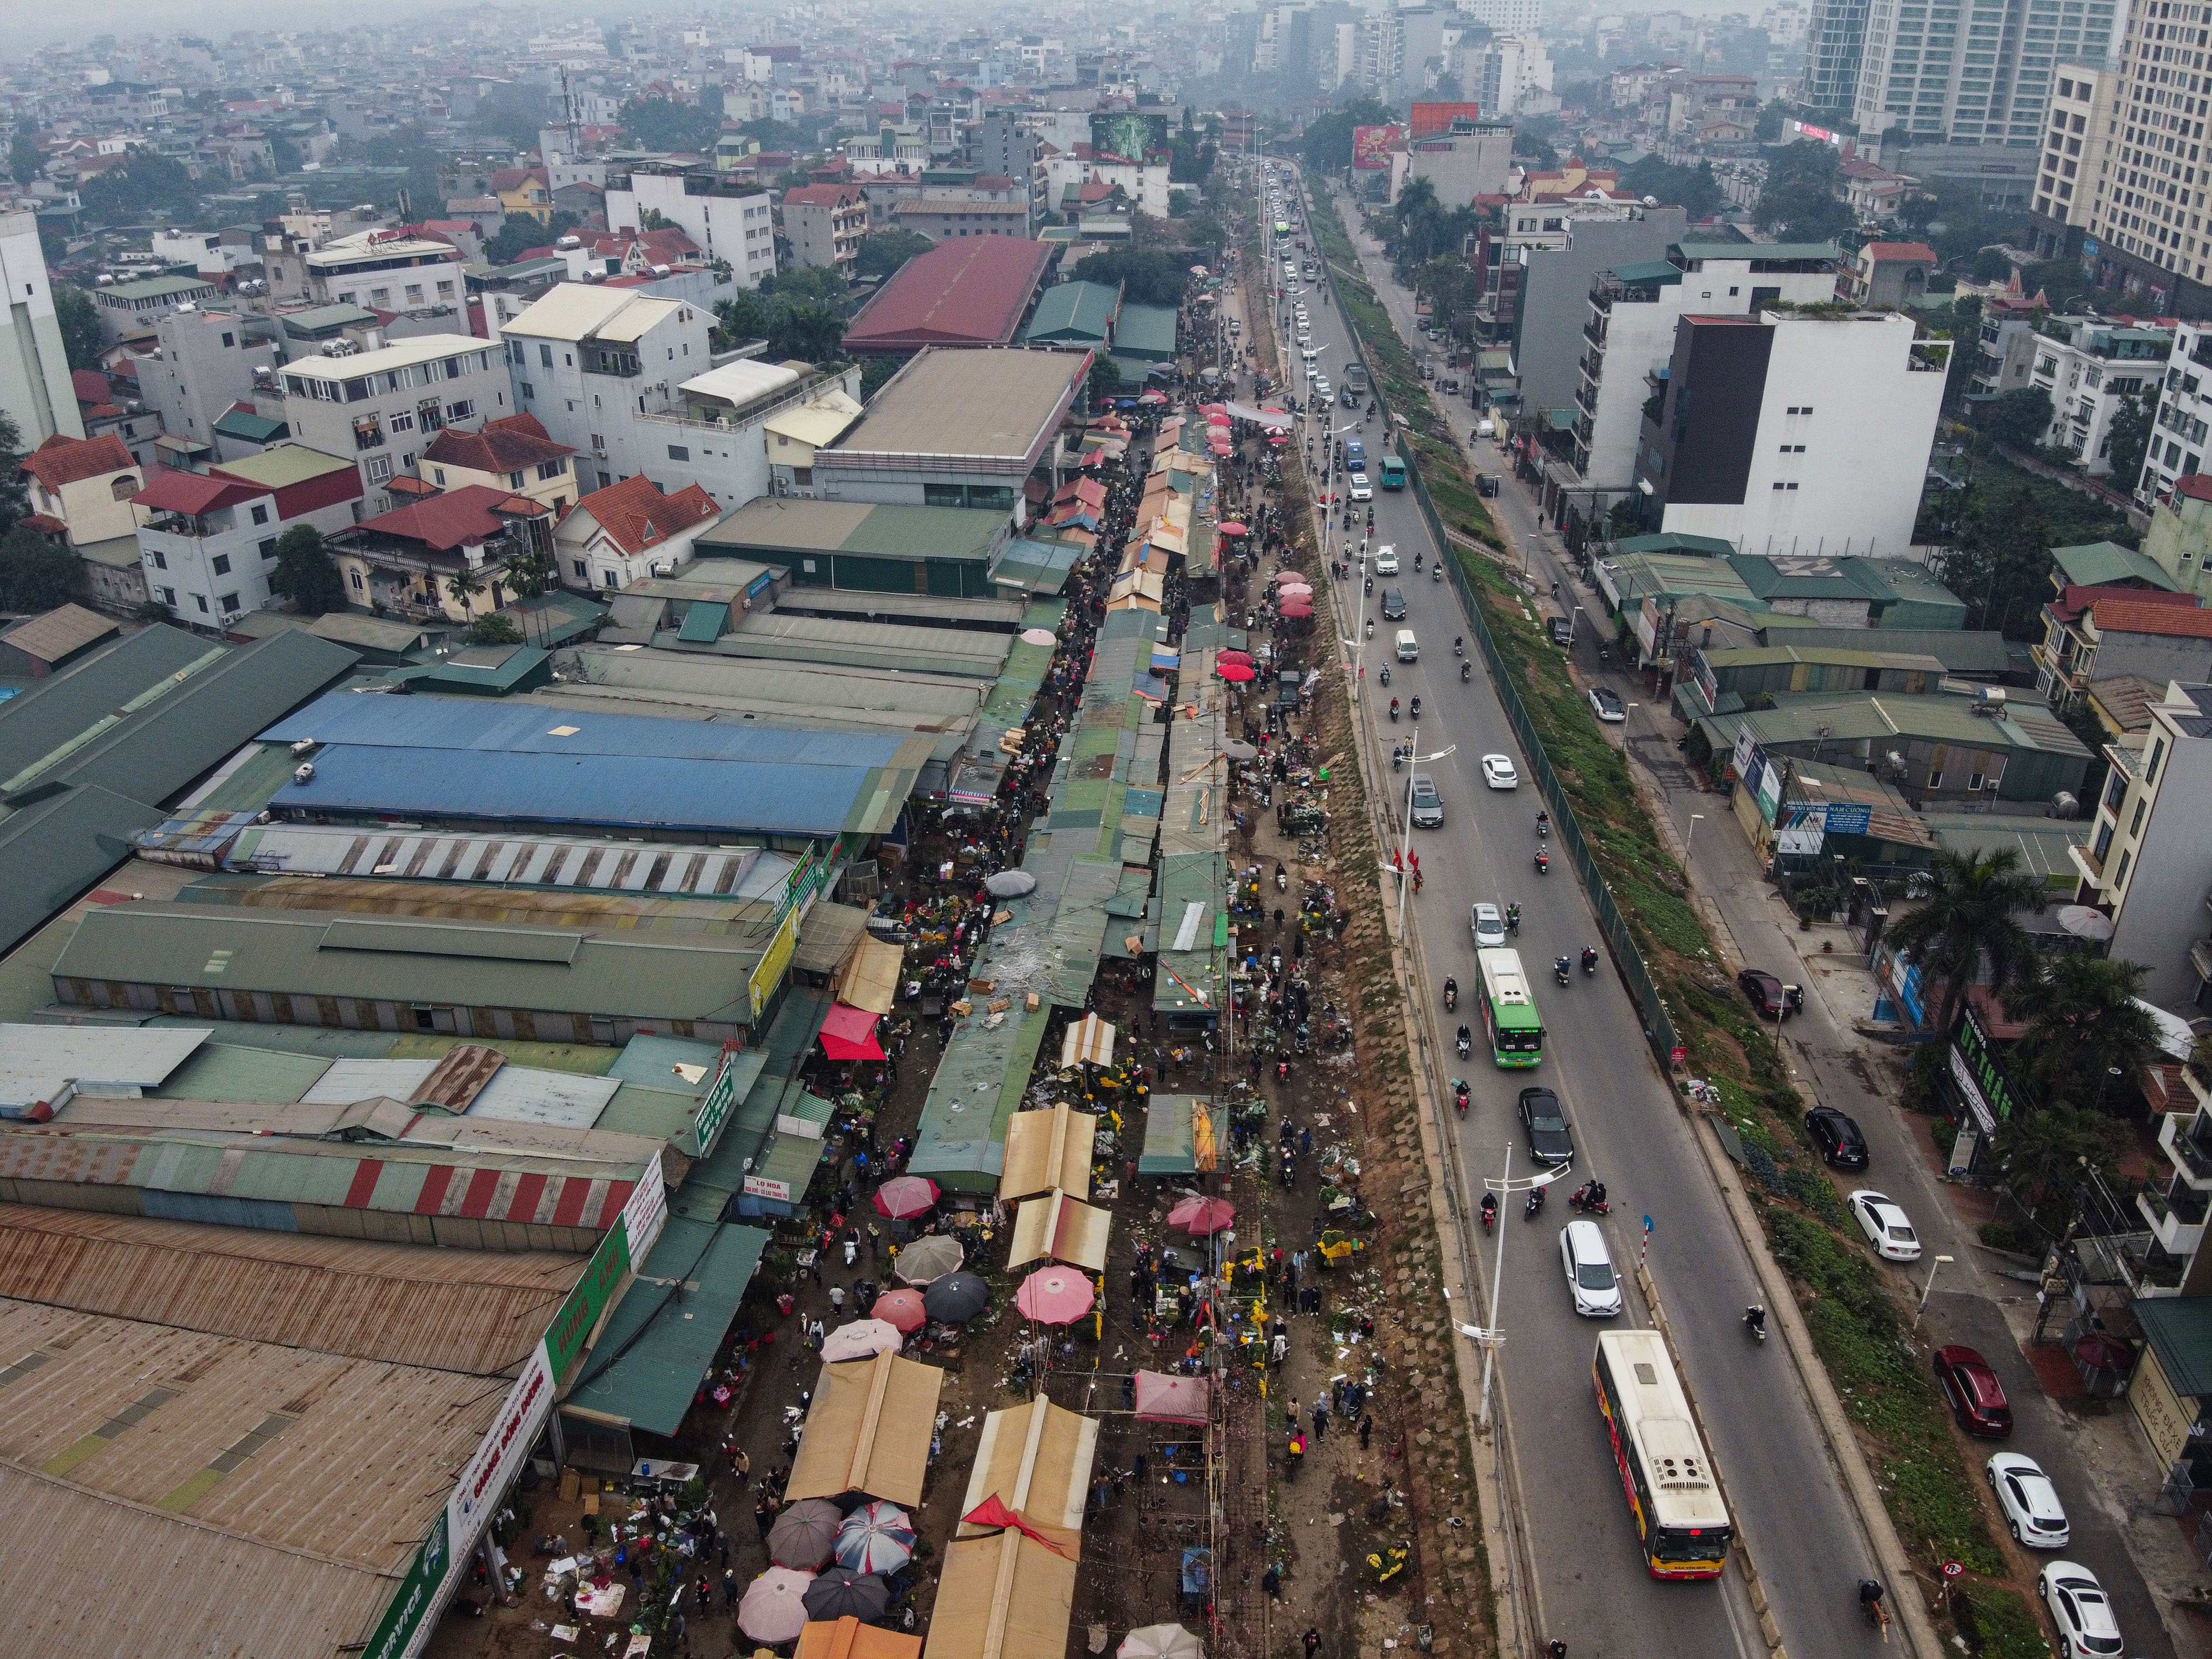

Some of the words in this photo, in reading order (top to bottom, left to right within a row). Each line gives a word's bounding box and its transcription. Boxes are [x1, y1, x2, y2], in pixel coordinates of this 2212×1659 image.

[710, 1087, 719, 1107] LAN
[456, 1484, 467, 1506] CÔNG
[466, 1476, 471, 1488] TY
[472, 1460, 481, 1479] TNHH
[481, 1438, 494, 1463] THƯƠNG
[499, 1413, 508, 1431] DỊCH
[507, 1405, 513, 1418] VỤ
[474, 1446, 501, 1499] GARAGE
[500, 1408, 521, 1450] ĐÔNG
[424, 1599, 439, 1621] KINH
[435, 1566, 456, 1599] DOANH
[453, 1547, 466, 1567] HOA
